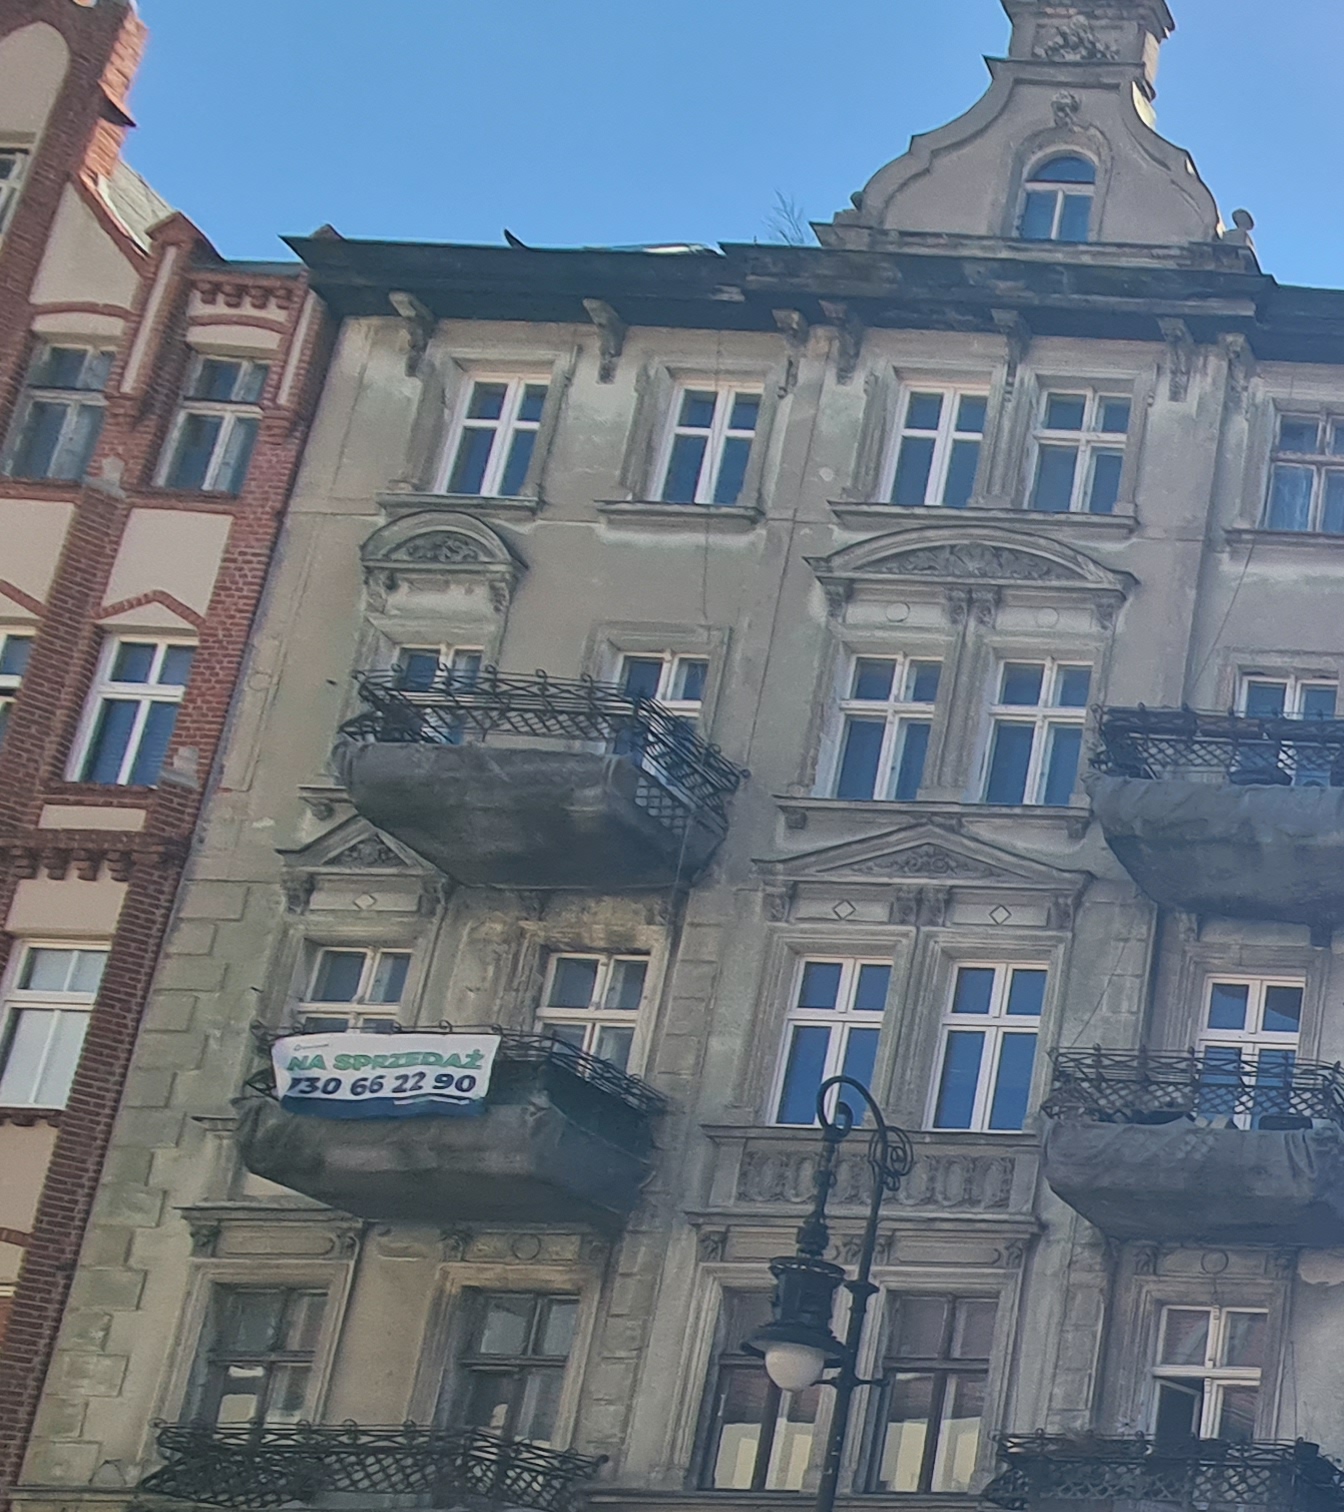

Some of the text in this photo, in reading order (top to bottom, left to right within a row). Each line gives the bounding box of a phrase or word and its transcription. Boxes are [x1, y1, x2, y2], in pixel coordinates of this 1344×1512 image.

[286, 1049, 485, 1071] NA SPRZEDAŻ
[350, 1075, 385, 1096] 66
[392, 1071, 426, 1093] 22
[432, 1073, 477, 1093] 90
